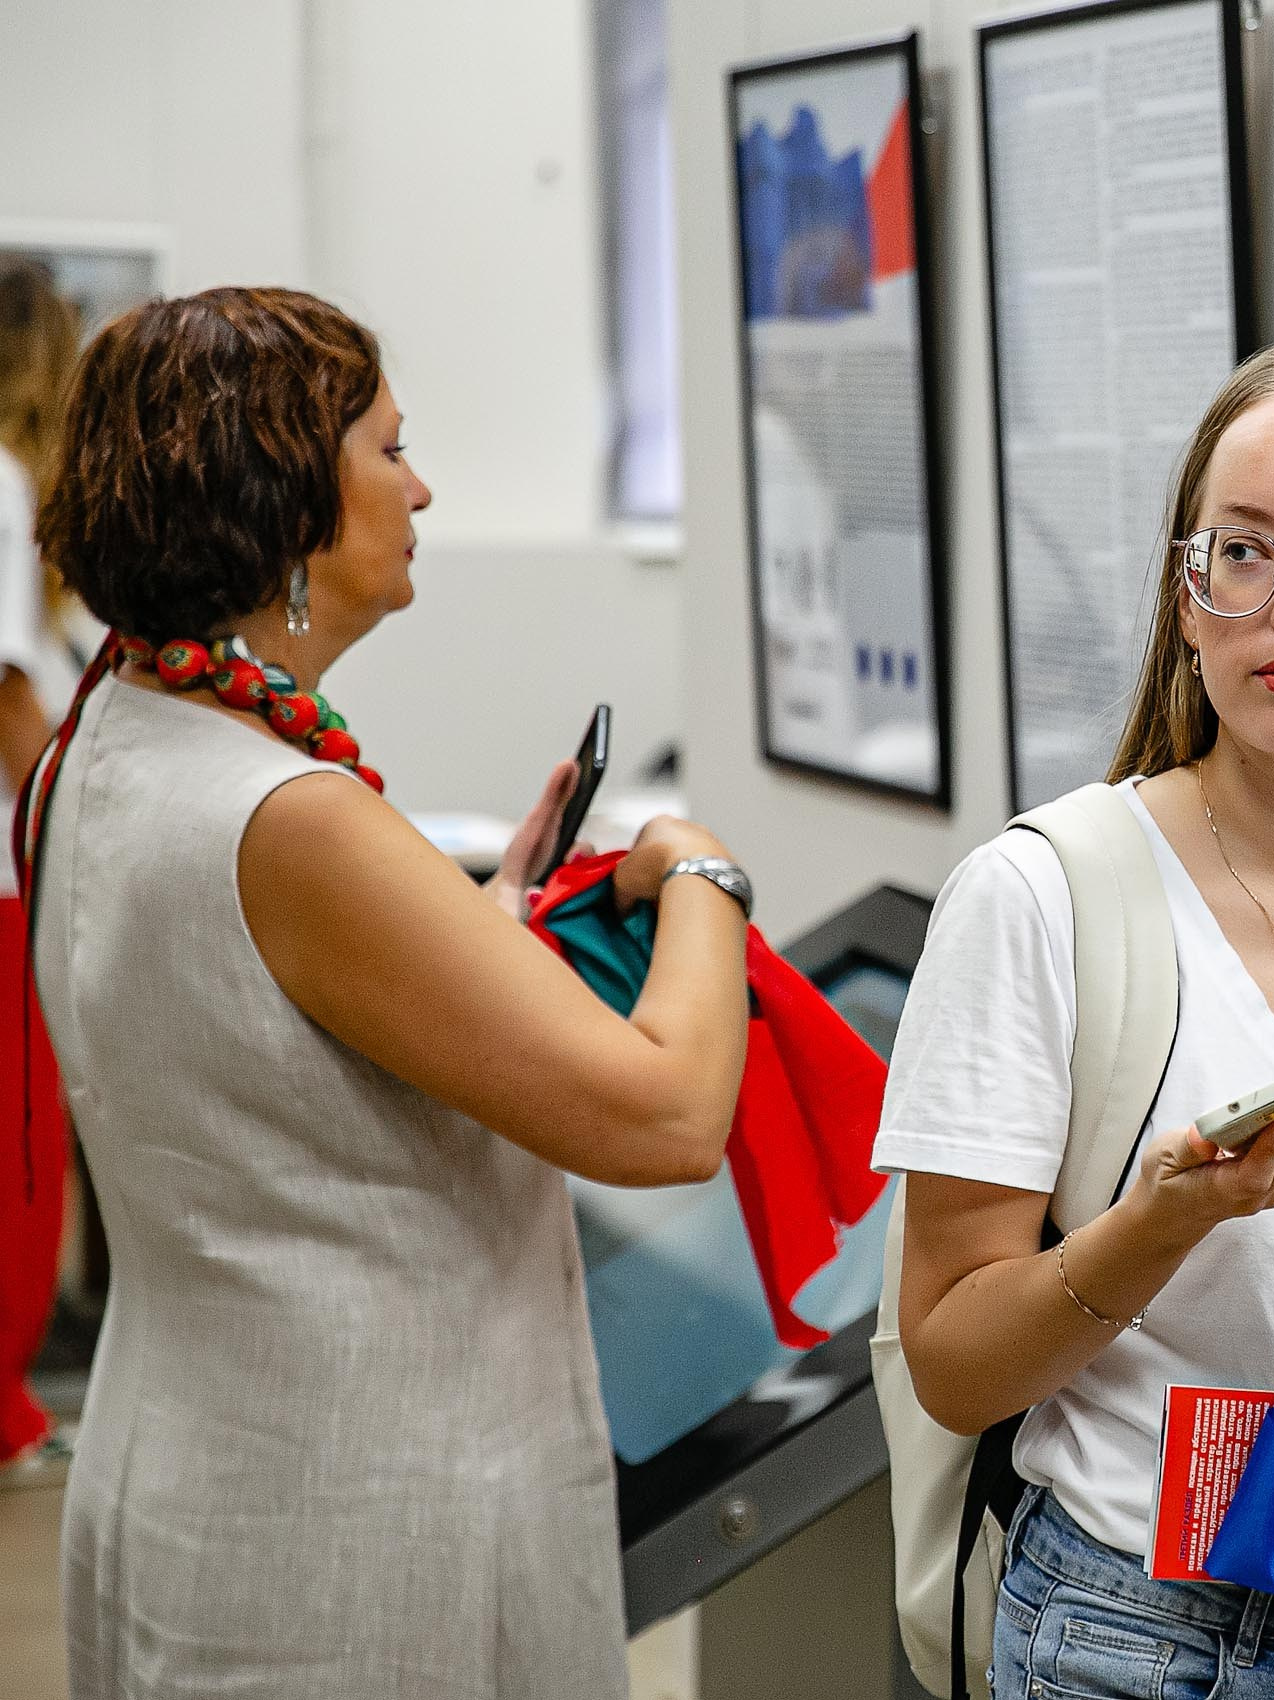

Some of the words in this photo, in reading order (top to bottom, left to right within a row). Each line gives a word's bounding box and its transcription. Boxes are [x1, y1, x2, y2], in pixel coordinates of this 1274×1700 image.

[1191, 1398, 1202, 1448] абстрактным
[1210, 1399, 1219, 1441] живописи
[1219, 1399, 1228, 1431] разделе
[1235, 1417, 1244, 1440] всего,
[1217, 1431, 1225, 1449] этом
[1220, 1441, 1233, 1505] произведения,
[1228, 1400, 1237, 1437] которые
[1232, 1443, 1241, 1469] против
[1206, 1444, 1217, 1482] характер
[1188, 1532, 1197, 1571] поискам
[1193, 1457, 1205, 1519] представляет
[1200, 1398, 1211, 1453] осознанный
[1196, 1486, 1211, 1571] экспериментальный
[1209, 1496, 1218, 1528] русском
